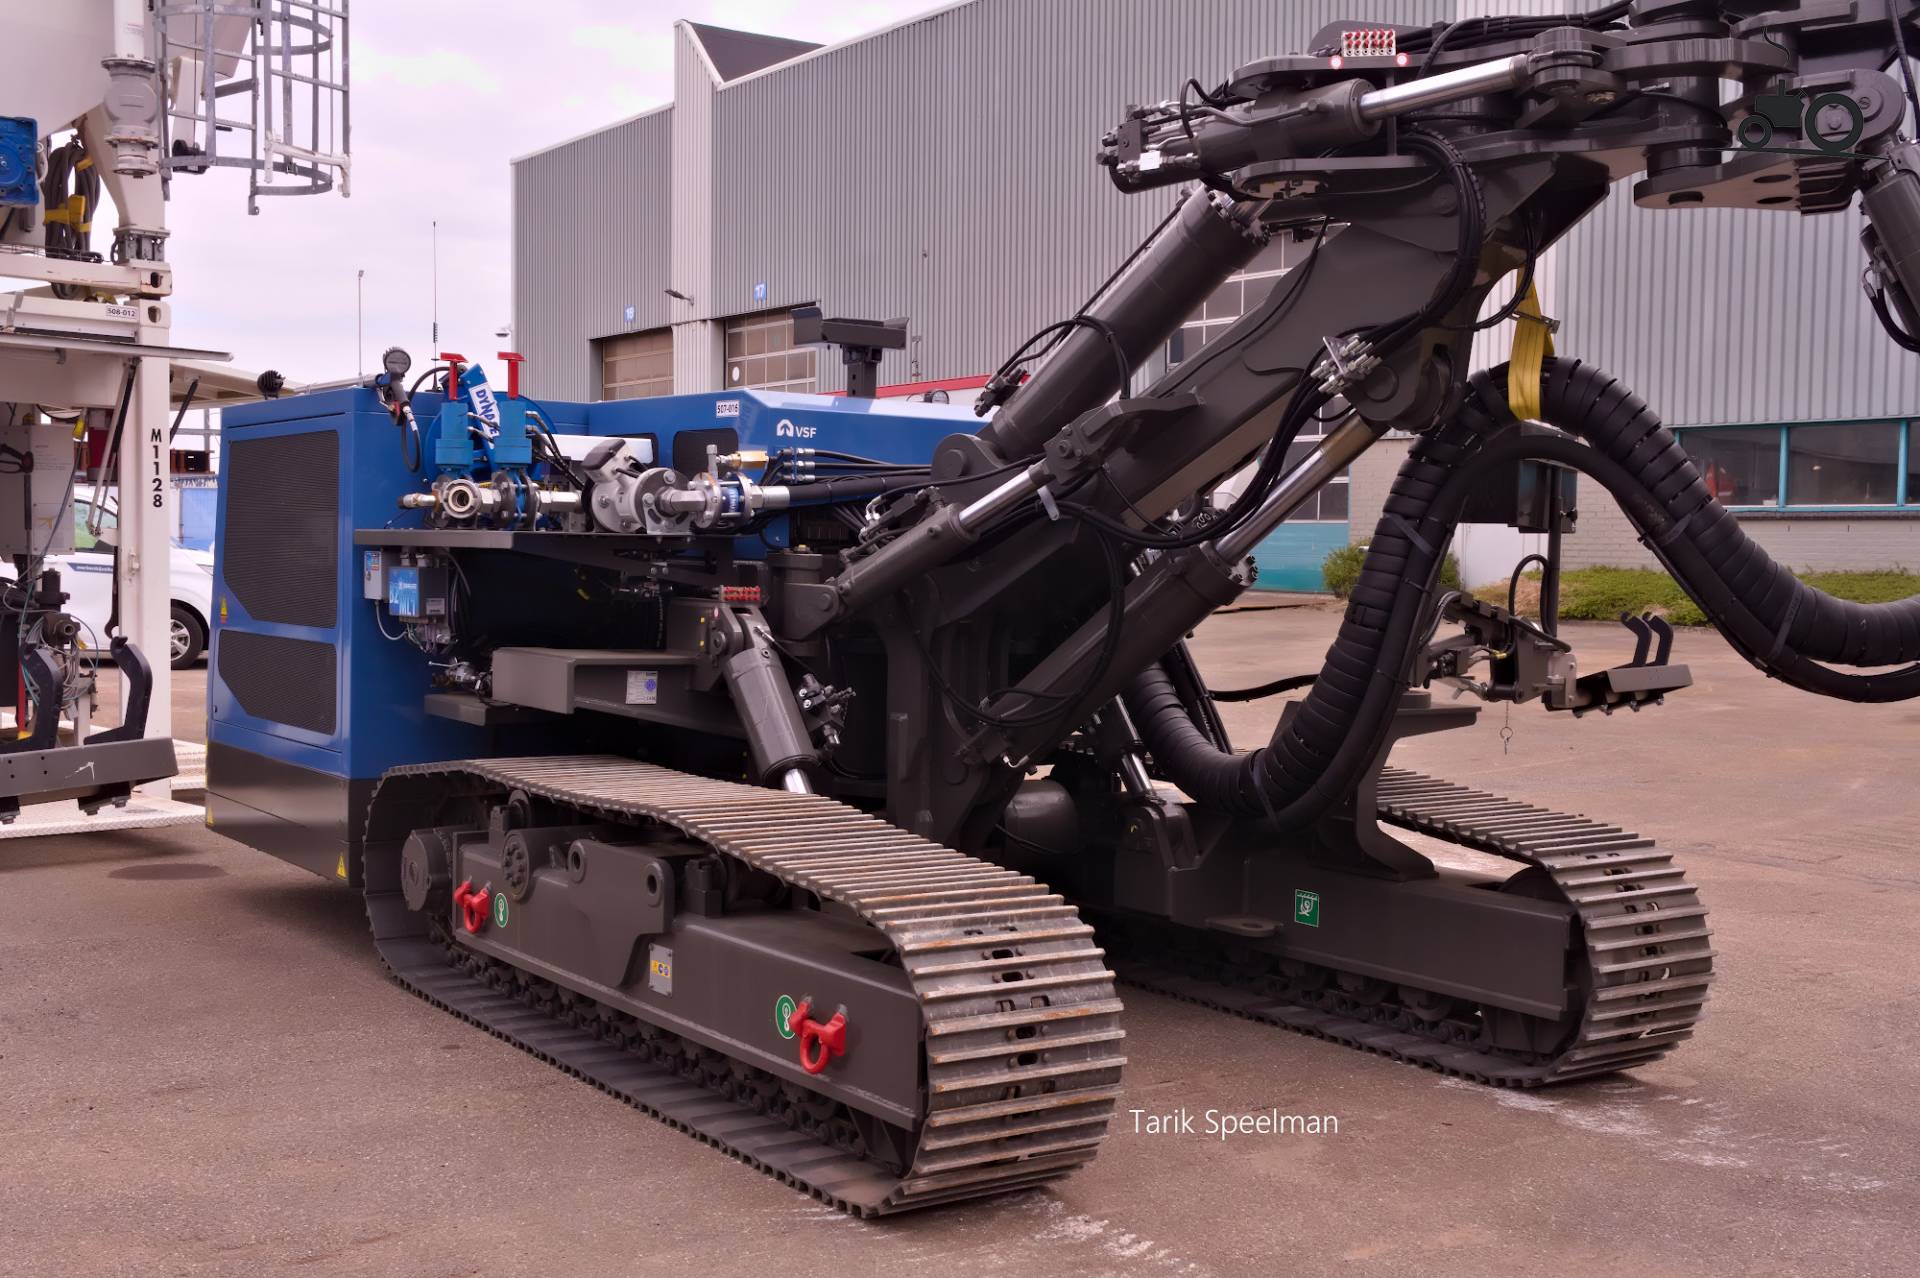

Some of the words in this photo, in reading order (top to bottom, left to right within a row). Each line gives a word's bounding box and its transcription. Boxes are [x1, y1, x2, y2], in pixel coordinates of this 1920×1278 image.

[754, 284, 765, 297] 17
[795, 426, 817, 438] VSF
[150, 428, 163, 508] M1128
